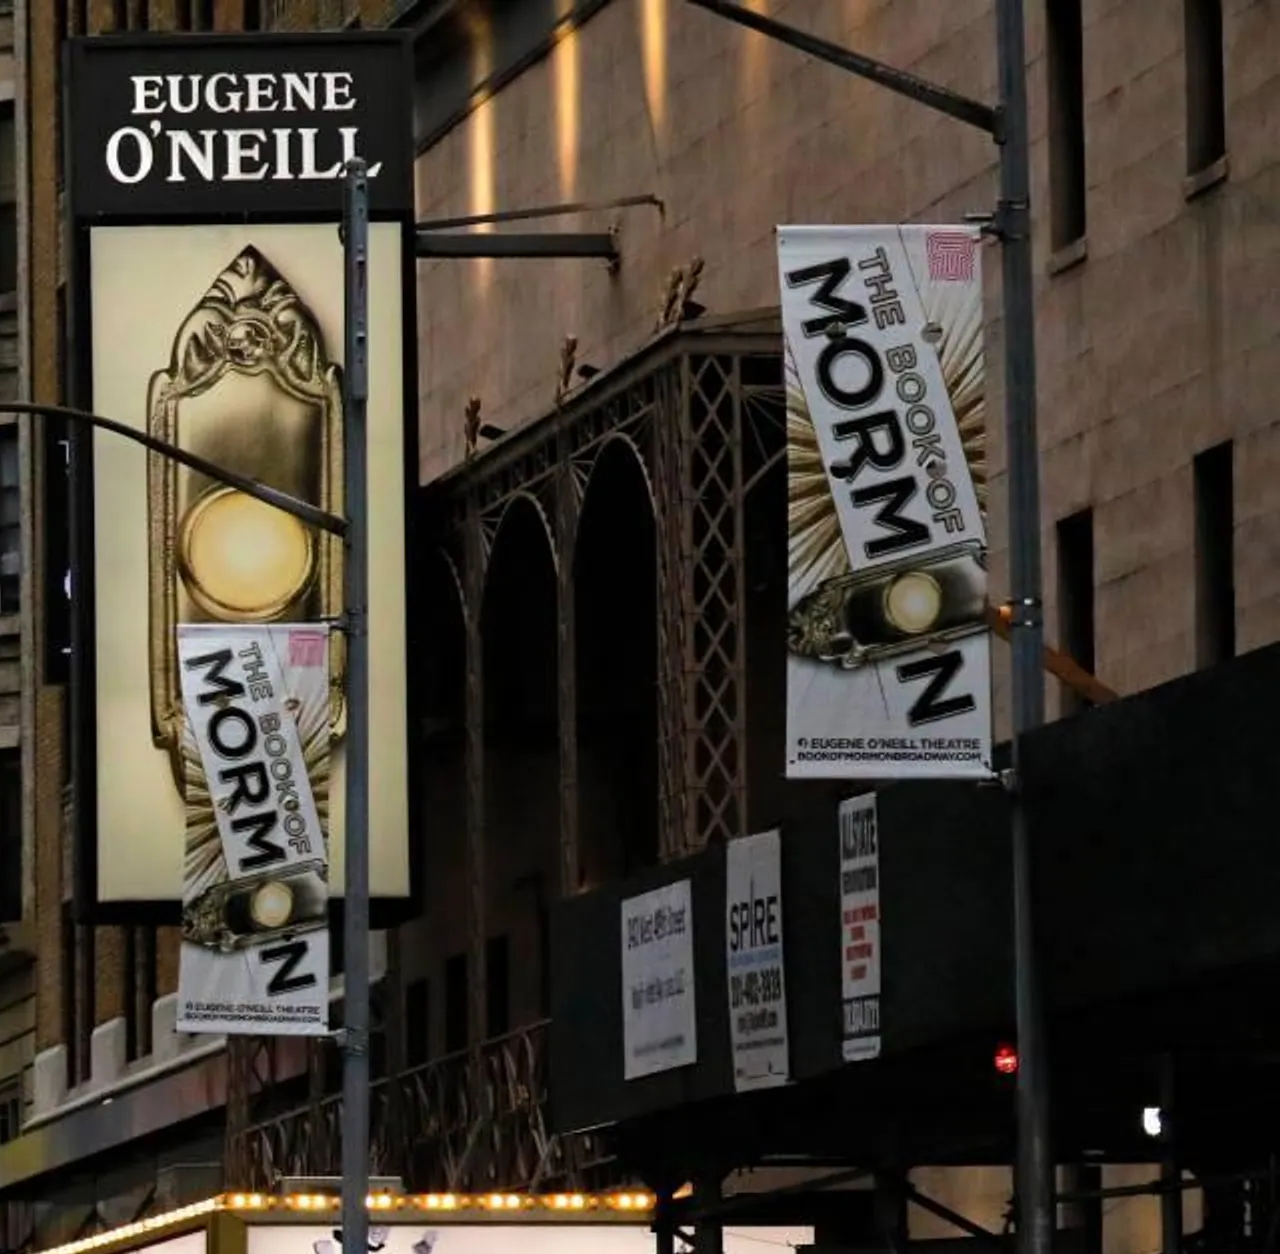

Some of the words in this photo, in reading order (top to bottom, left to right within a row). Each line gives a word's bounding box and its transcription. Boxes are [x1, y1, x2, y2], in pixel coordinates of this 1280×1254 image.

[130, 72, 357, 115] EUGENE
[105, 120, 383, 184] O'NEILL
[857, 247, 907, 330] THE
[885, 343, 947, 468] BOOK
[926, 477, 965, 534] OF
[239, 641, 273, 702] THE
[258, 712, 298, 801] BOOK
[283, 806, 313, 855] OF
[811, 738, 864, 750] EUGENE
[867, 738, 918, 750] O'NEILL
[921, 738, 982, 750] THEATRE
[731, 895, 779, 951] SPIRE
